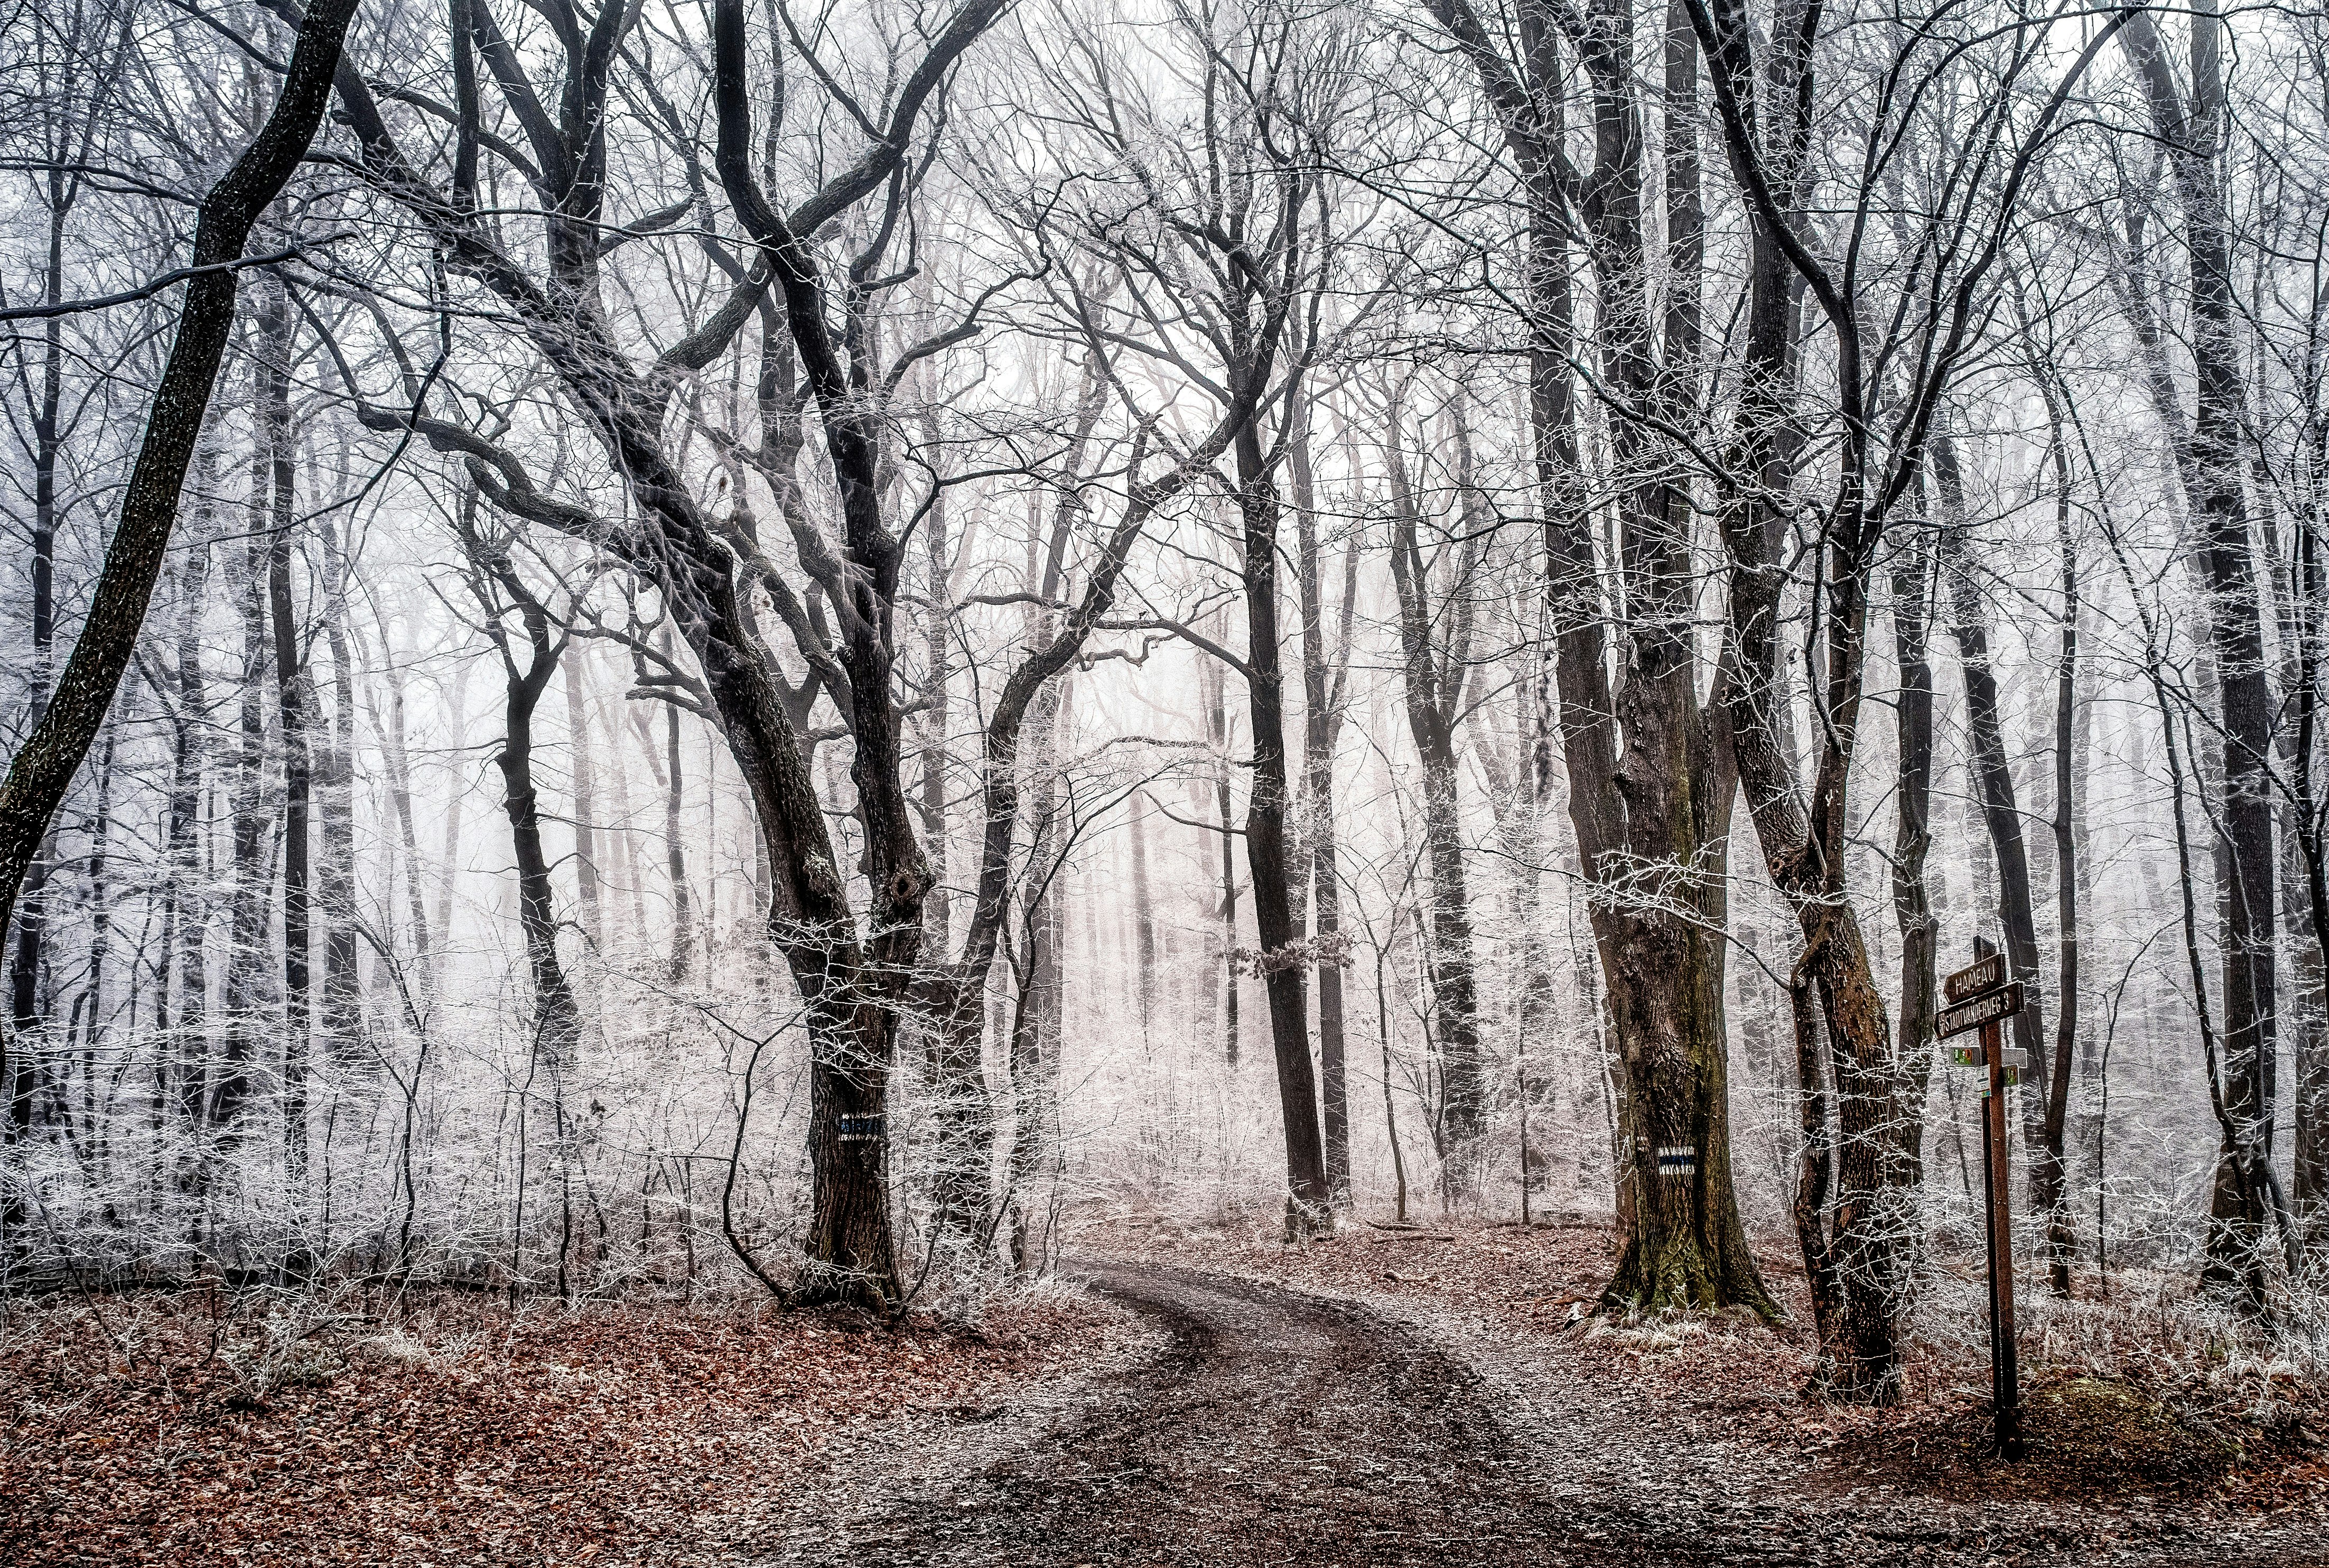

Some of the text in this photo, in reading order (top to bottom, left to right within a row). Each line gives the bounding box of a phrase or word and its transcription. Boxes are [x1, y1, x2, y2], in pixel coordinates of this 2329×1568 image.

[1955, 963, 1995, 995] HAMEAU
[1945, 991, 2009, 1031] STADTWANDERWEG 3
